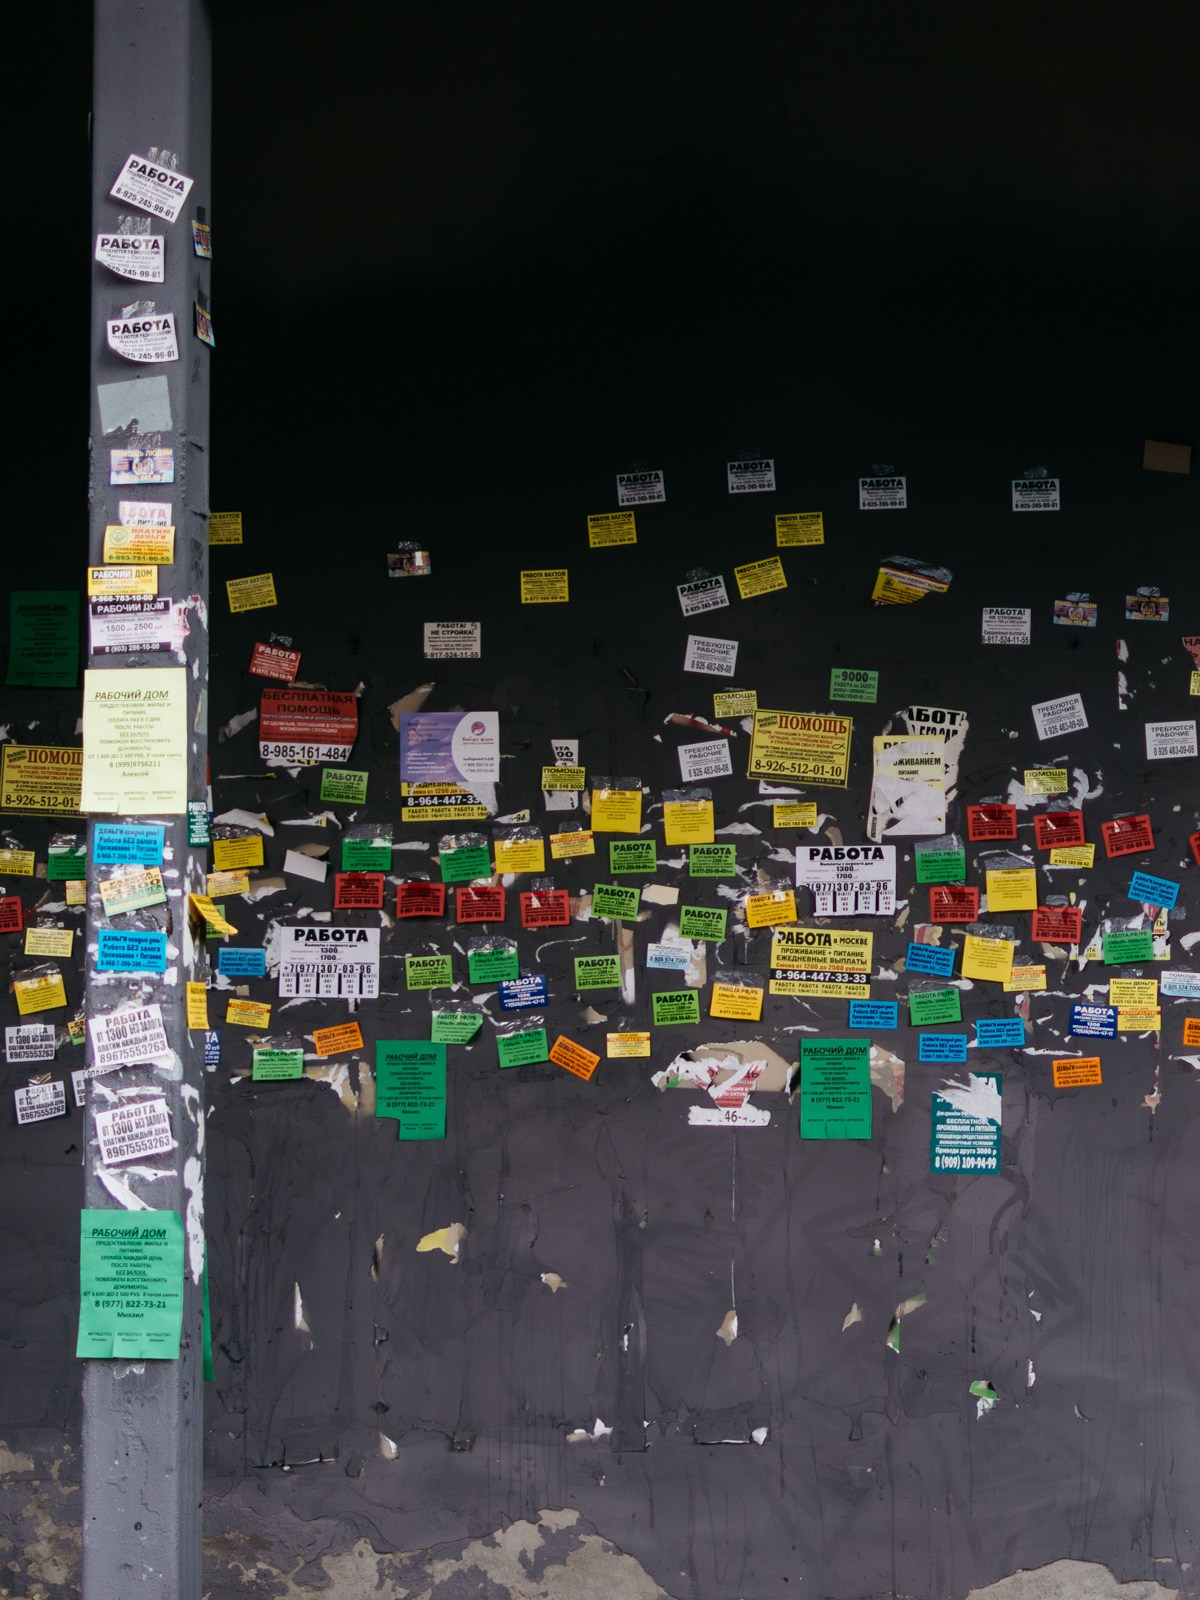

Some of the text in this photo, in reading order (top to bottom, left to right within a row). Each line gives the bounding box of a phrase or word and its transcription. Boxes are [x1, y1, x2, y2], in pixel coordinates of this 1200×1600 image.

[128, 160, 184, 191] РАБОТА
[116, 187, 174, 218] 8-925-245-99-01
[101, 238, 160, 249] РАБОТА
[112, 319, 171, 334] РАБОТА
[729, 461, 771, 471] РАБОТА
[619, 472, 661, 484] РАБОТА
[862, 479, 903, 488] РАБОТА
[93, 569, 152, 578] РАБОЧИЙ ДОМ
[97, 602, 164, 613] РАБОЧИЙ ДОМ
[693, 639, 736, 651] ТРЕБУЮТСЯ
[697, 646, 730, 656] РАБОЧИЕ
[258, 645, 296, 660] РАБОТА
[95, 690, 169, 701] РАБОЧИЙ ДОМ
[263, 691, 353, 704] БЕСПЛАТНАЯ
[277, 704, 340, 715] ПОМОЩЬ
[779, 714, 847, 733] ПОМОЩЬ
[116, 760, 161, 768] (999)9756211
[754, 759, 842, 777] 8-926-512-01-10
[326, 773, 363, 783] РАБОТА
[614, 843, 652, 852] РАБОТА
[693, 847, 731, 855] РАБОТА
[810, 847, 884, 860] РАБОТА
[294, 929, 368, 942] РАБОТА
[778, 931, 832, 946] РАБОТА
[284, 964, 371, 974] +7(977)307-03-96
[409, 959, 447, 968] РАБОТА
[775, 970, 866, 983] 8-964-447-33-33
[1075, 1006, 1114, 1015] РАБОТА
[105, 1011, 150, 1027] РАБОТА
[105, 1020, 162, 1040] 1300 БЕЗ ЗАЛОГА
[97, 1032, 164, 1052] ПЛАТИМ КАЖДЫЙ ДЕНЬ
[9, 1050, 54, 1059] 89675553263
[100, 1040, 165, 1064] 89675553263
[386, 1052, 437, 1061] РАБОЧИЙ ДОМ
[804, 1046, 867, 1055] РАБОЧИЙ ДОМ
[111, 1104, 156, 1121] РАБОТА
[106, 1136, 170, 1158] 89675553263
[935, 1157, 997, 1170] 8 (909) 109-94-99
[92, 1227, 166, 1239] РАБОЧИЙ ДОМ
[102, 1301, 123, 1309] (977)
